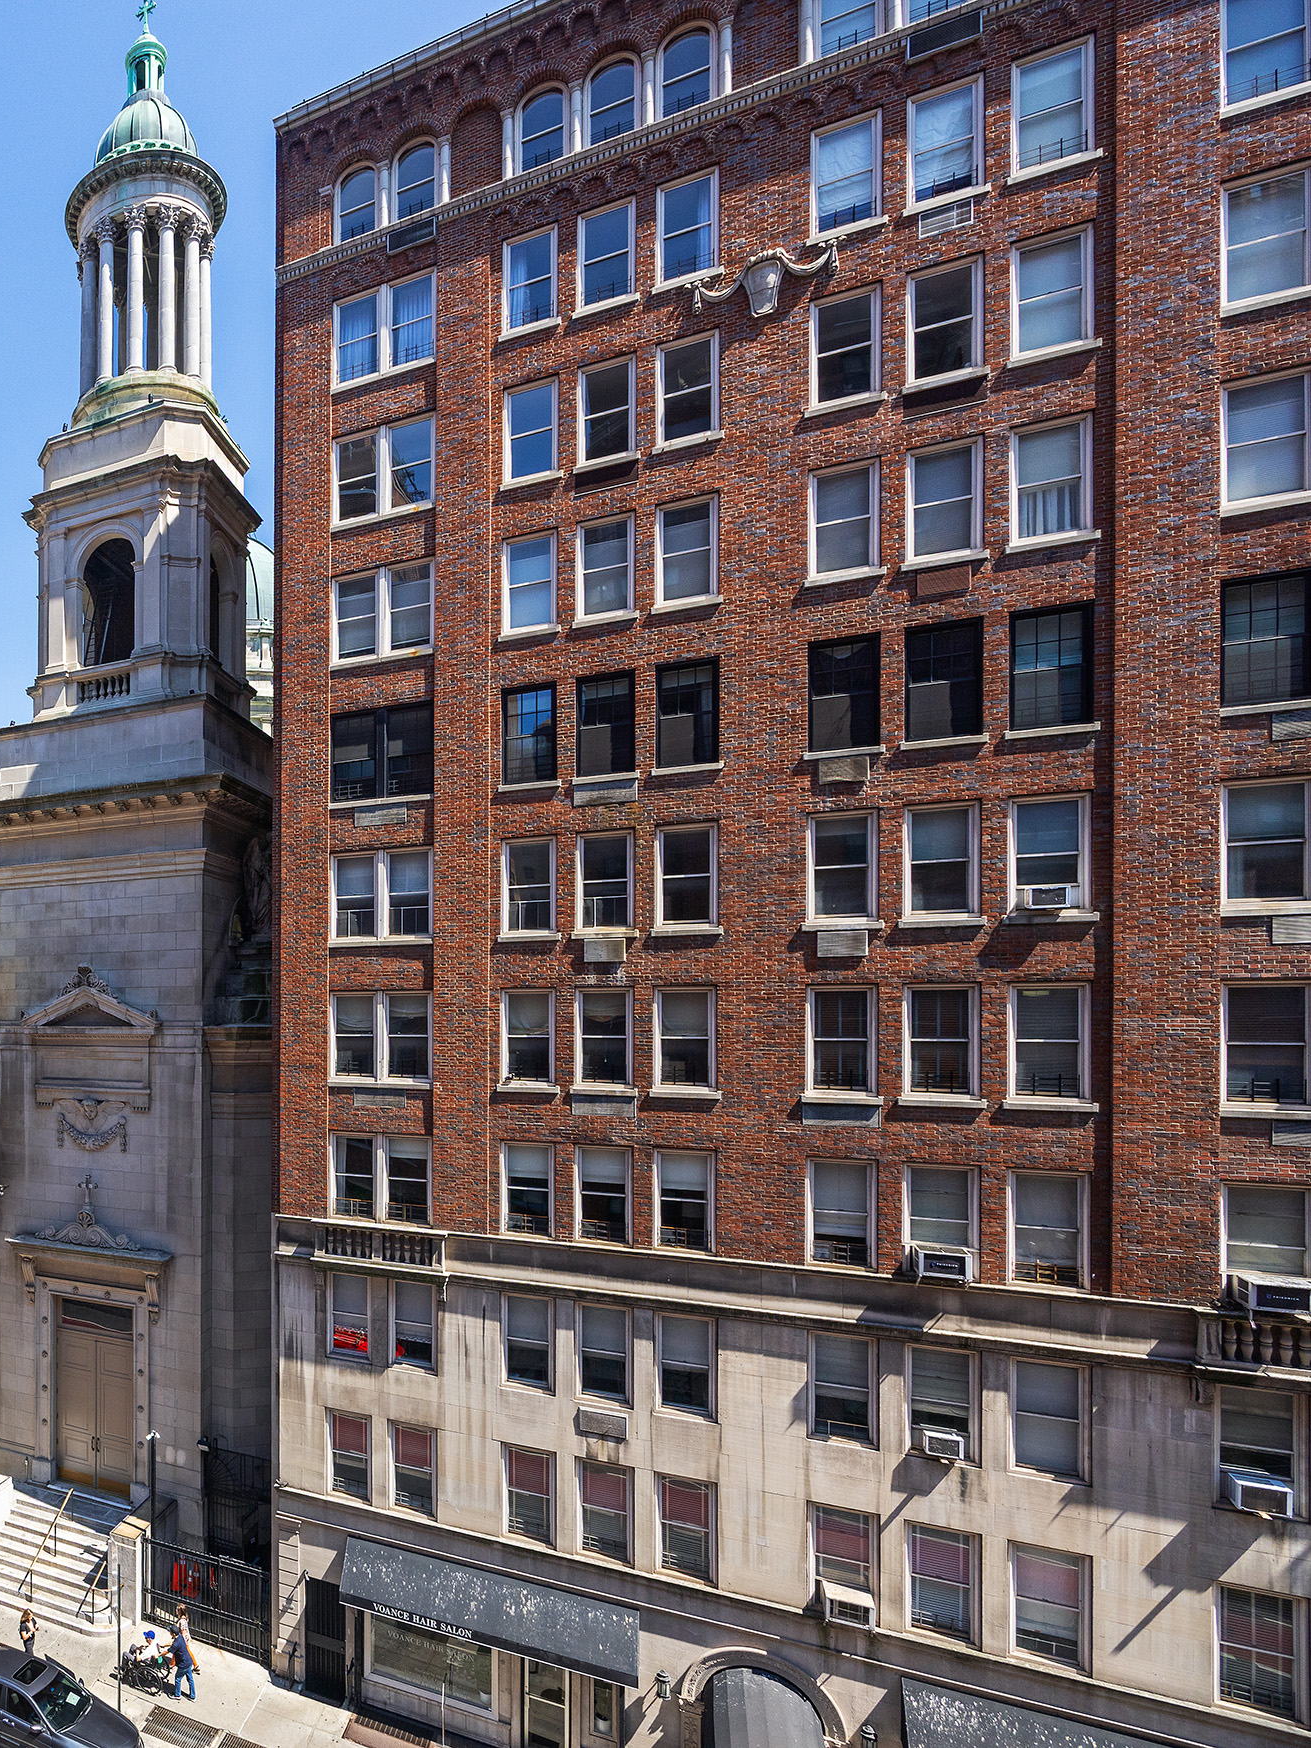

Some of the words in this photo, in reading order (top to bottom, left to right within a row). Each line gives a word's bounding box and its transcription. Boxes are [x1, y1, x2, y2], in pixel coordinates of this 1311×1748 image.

[373, 1602, 410, 1621] VOANCE
[413, 1614, 438, 1629] HAIR
[440, 1623, 473, 1639] SALON
[387, 1630, 422, 1646] VOANCE
[423, 1641, 444, 1653] HAIR
[446, 1648, 475, 1662] SALON
